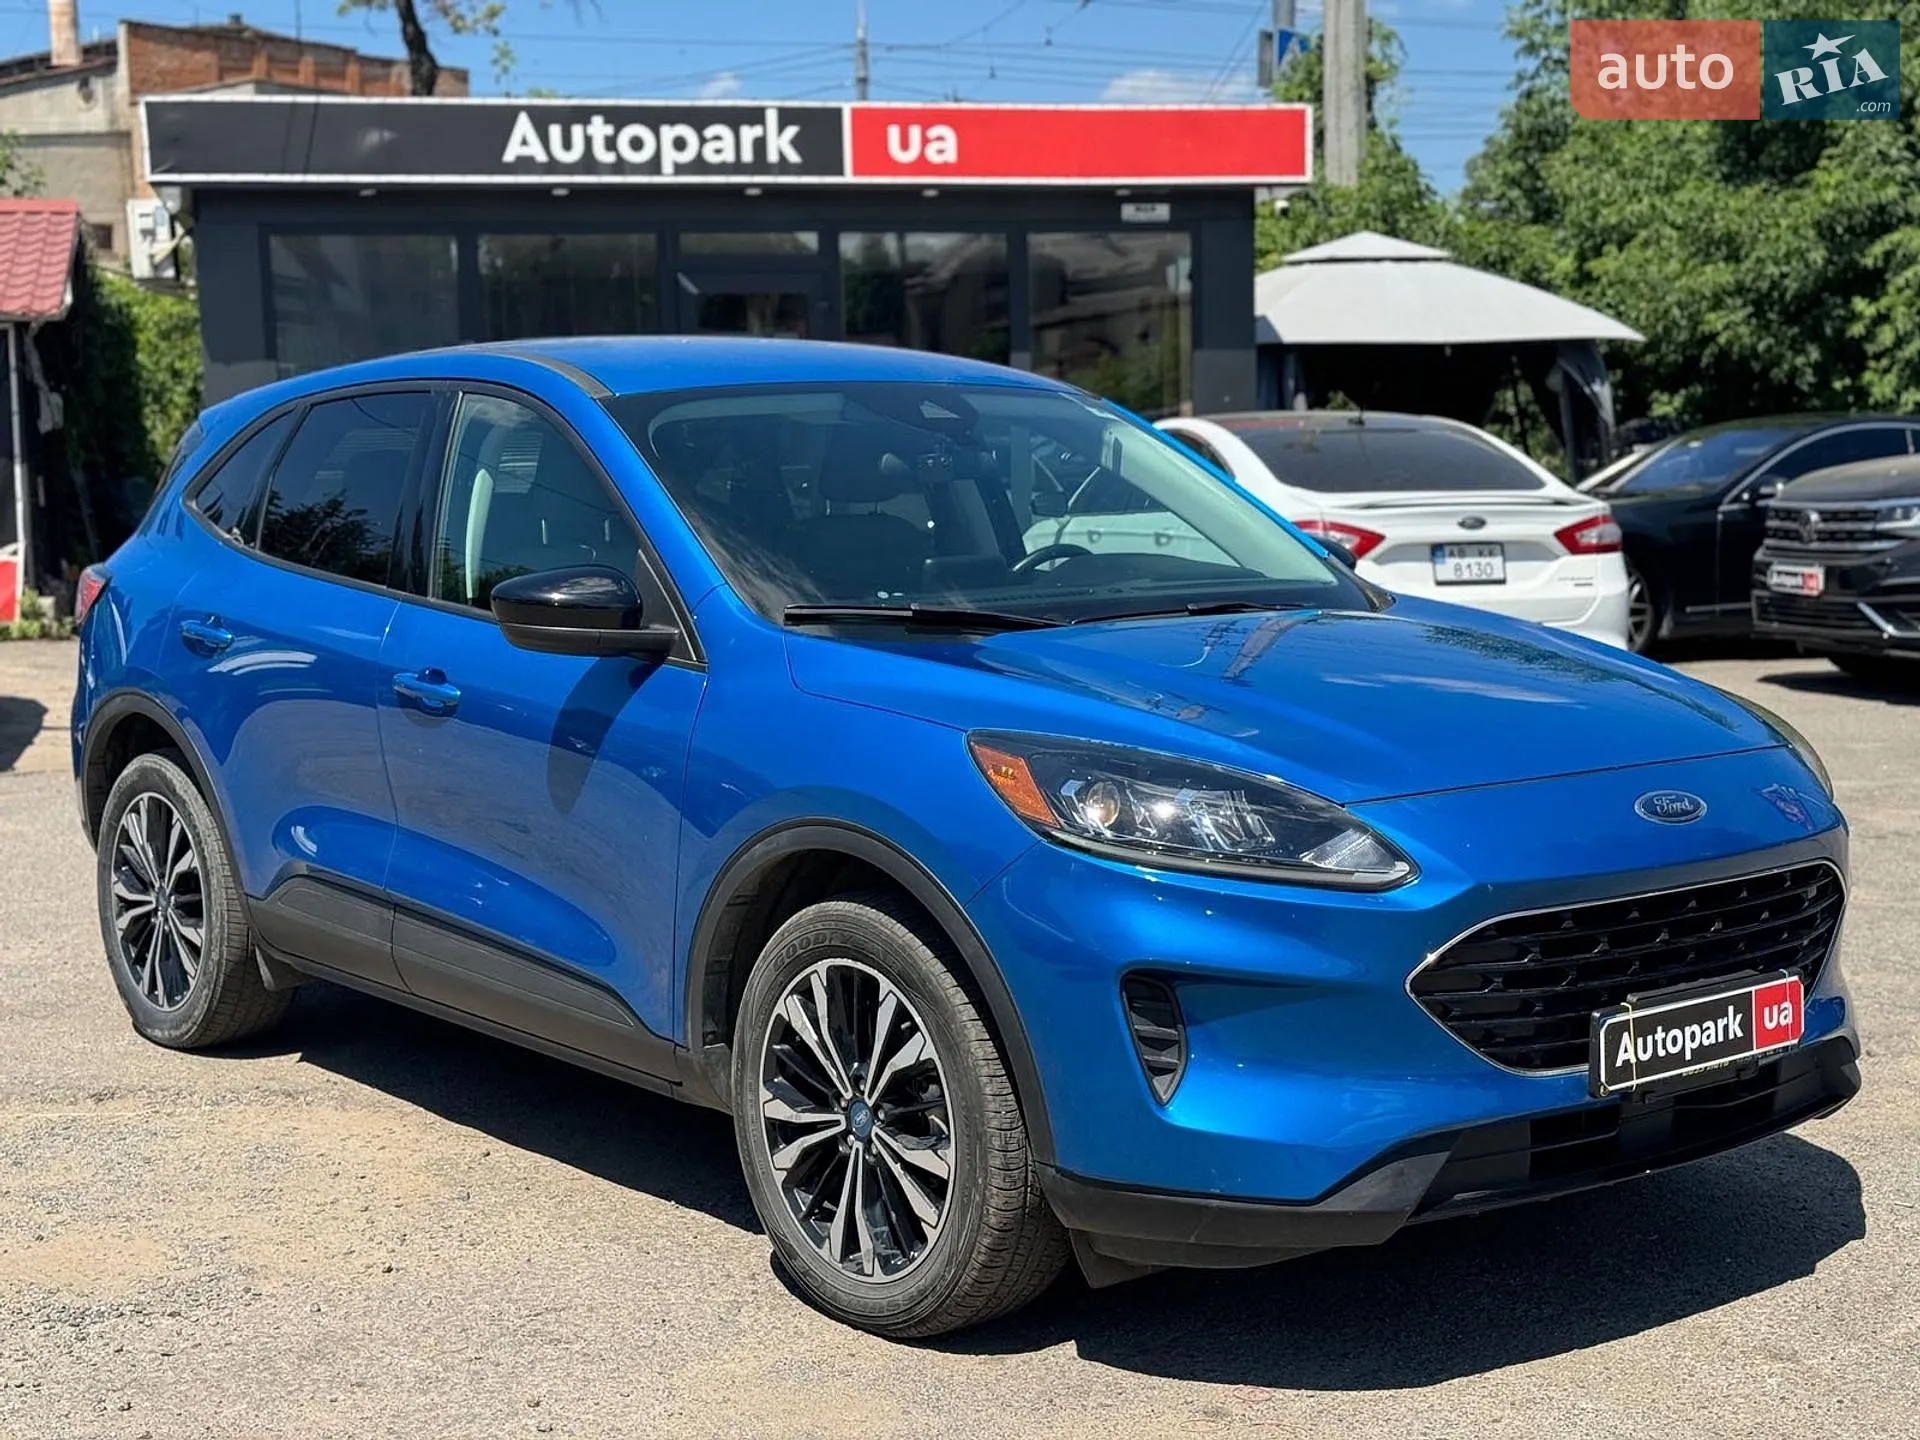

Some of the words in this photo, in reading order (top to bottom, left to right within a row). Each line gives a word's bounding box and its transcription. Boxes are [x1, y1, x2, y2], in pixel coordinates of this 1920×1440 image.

[502, 107, 802, 175] Autopark
[887, 123, 958, 164] ua
[1453, 561, 1494, 578] 8130
[1652, 794, 1695, 815] Ford
[1615, 1005, 1745, 1068] Autopark
[1763, 1000, 1794, 1030] ua
